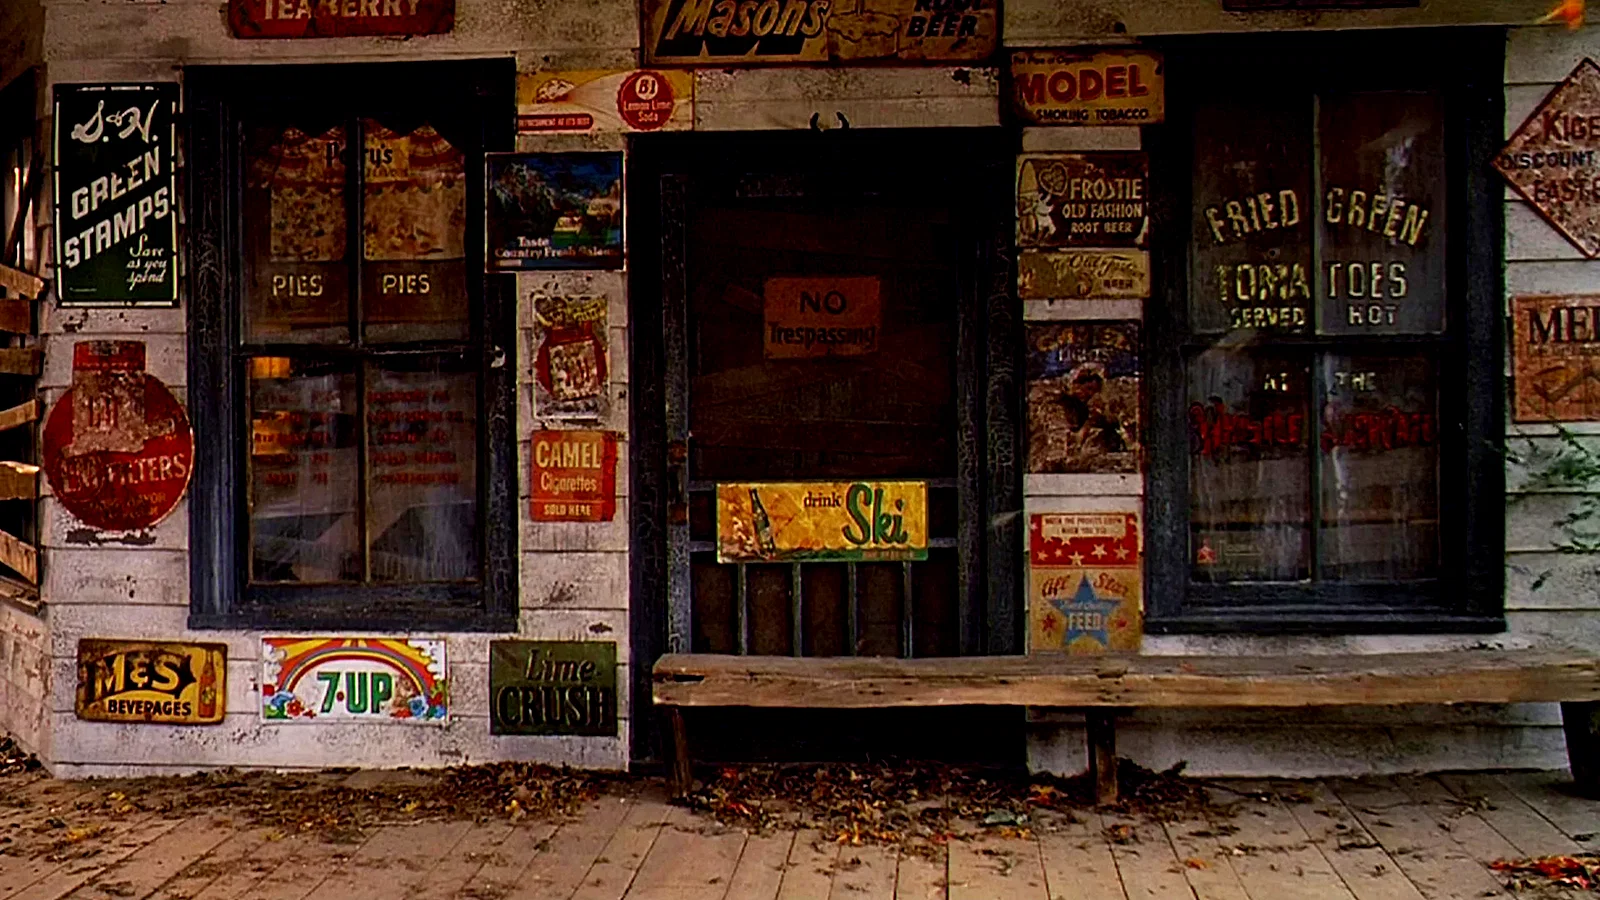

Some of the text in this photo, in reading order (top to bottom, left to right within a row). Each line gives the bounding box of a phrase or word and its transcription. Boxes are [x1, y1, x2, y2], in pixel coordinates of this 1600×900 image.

[906, 15, 978, 37] BEER
[1015, 64, 1149, 106] MODEL
[623, 100, 672, 111] Lemon Lime
[638, 111, 658, 122] Soda
[1036, 108, 1149, 121] SMOKING TOBACCO
[1500, 151, 1594, 169] DISCOUNT
[71, 145, 160, 220] GREEN
[1069, 178, 1143, 200] FROSTIE
[1062, 203, 1143, 218] OLD FASHION
[1205, 187, 1429, 246] FRIED GREEN
[64, 186, 170, 269] STAMPS
[1070, 222, 1133, 233] ROOT BEER
[129, 233, 165, 258] Save
[516, 235, 550, 247] Taste
[494, 248, 542, 259] Country
[125, 258, 168, 281] as you
[126, 269, 167, 291] spend
[271, 274, 324, 296] PIES
[382, 273, 431, 295] PIES
[800, 290, 847, 314] NO
[1230, 304, 1396, 328] SERVED HOT
[768, 321, 875, 348] Trespassing
[1264, 371, 1376, 391] AT THE
[535, 440, 601, 469] CAMEL
[106, 453, 187, 485] FILTERS
[541, 471, 597, 495] Cigarettes
[543, 503, 591, 516] SOLD HERE
[803, 484, 908, 545] drink Ski
[525, 648, 597, 681] Lime
[107, 699, 192, 716] BEVERAGES
[496, 685, 615, 726] CRUSH
